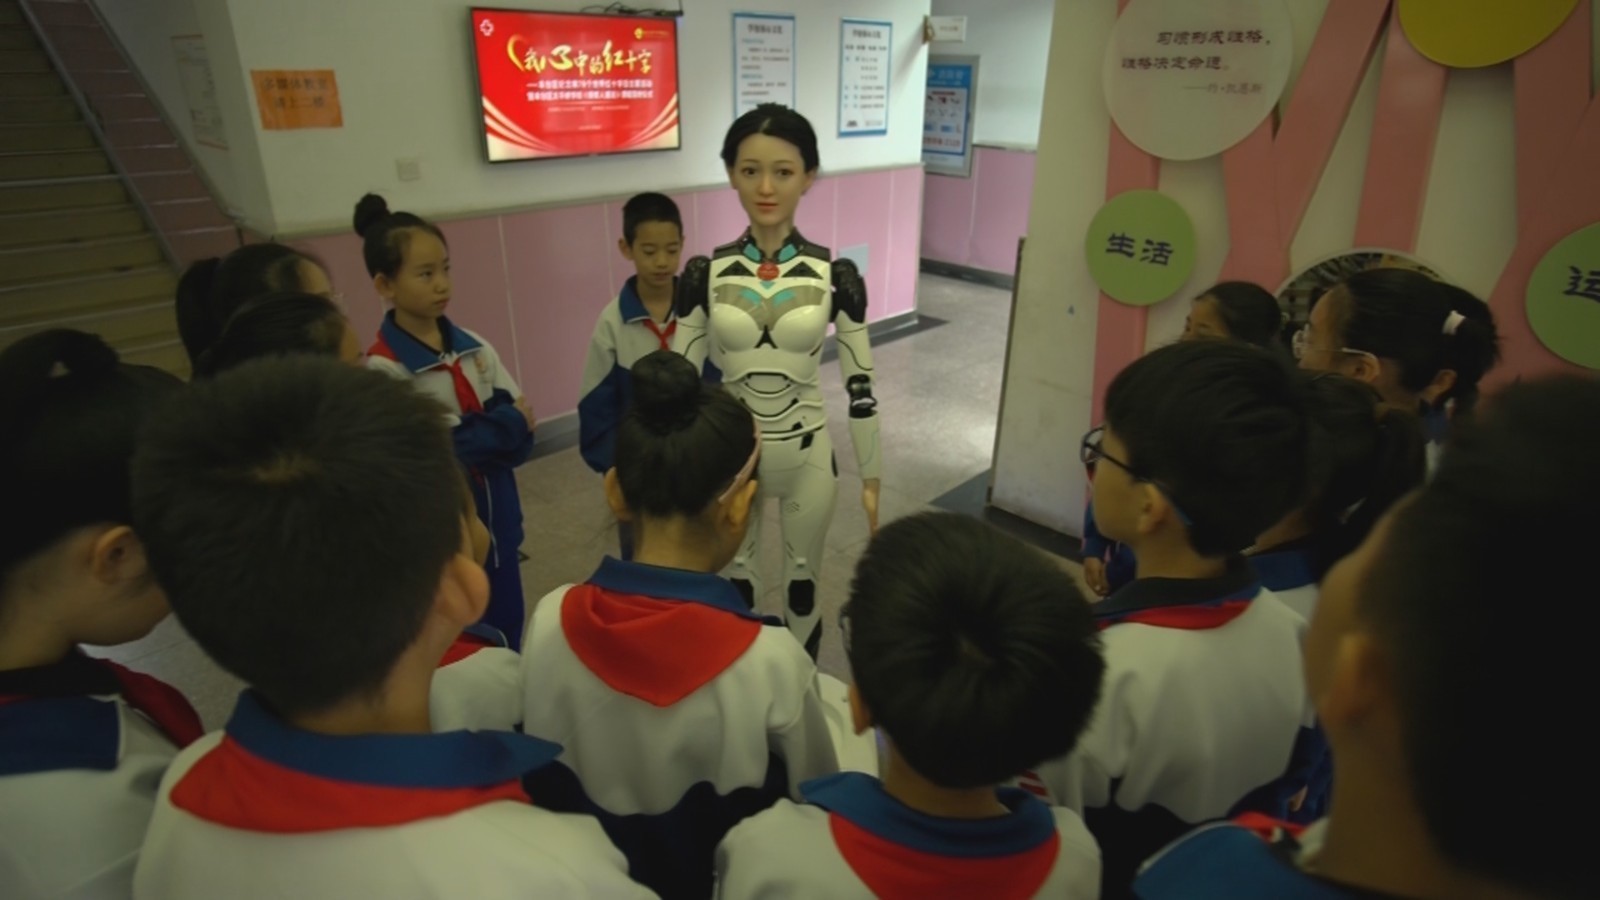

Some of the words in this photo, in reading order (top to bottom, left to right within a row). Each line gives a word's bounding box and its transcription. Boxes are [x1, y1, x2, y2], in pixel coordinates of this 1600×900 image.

[523, 39, 653, 77] 我心中的红十字
[1105, 232, 1174, 266] 生活
